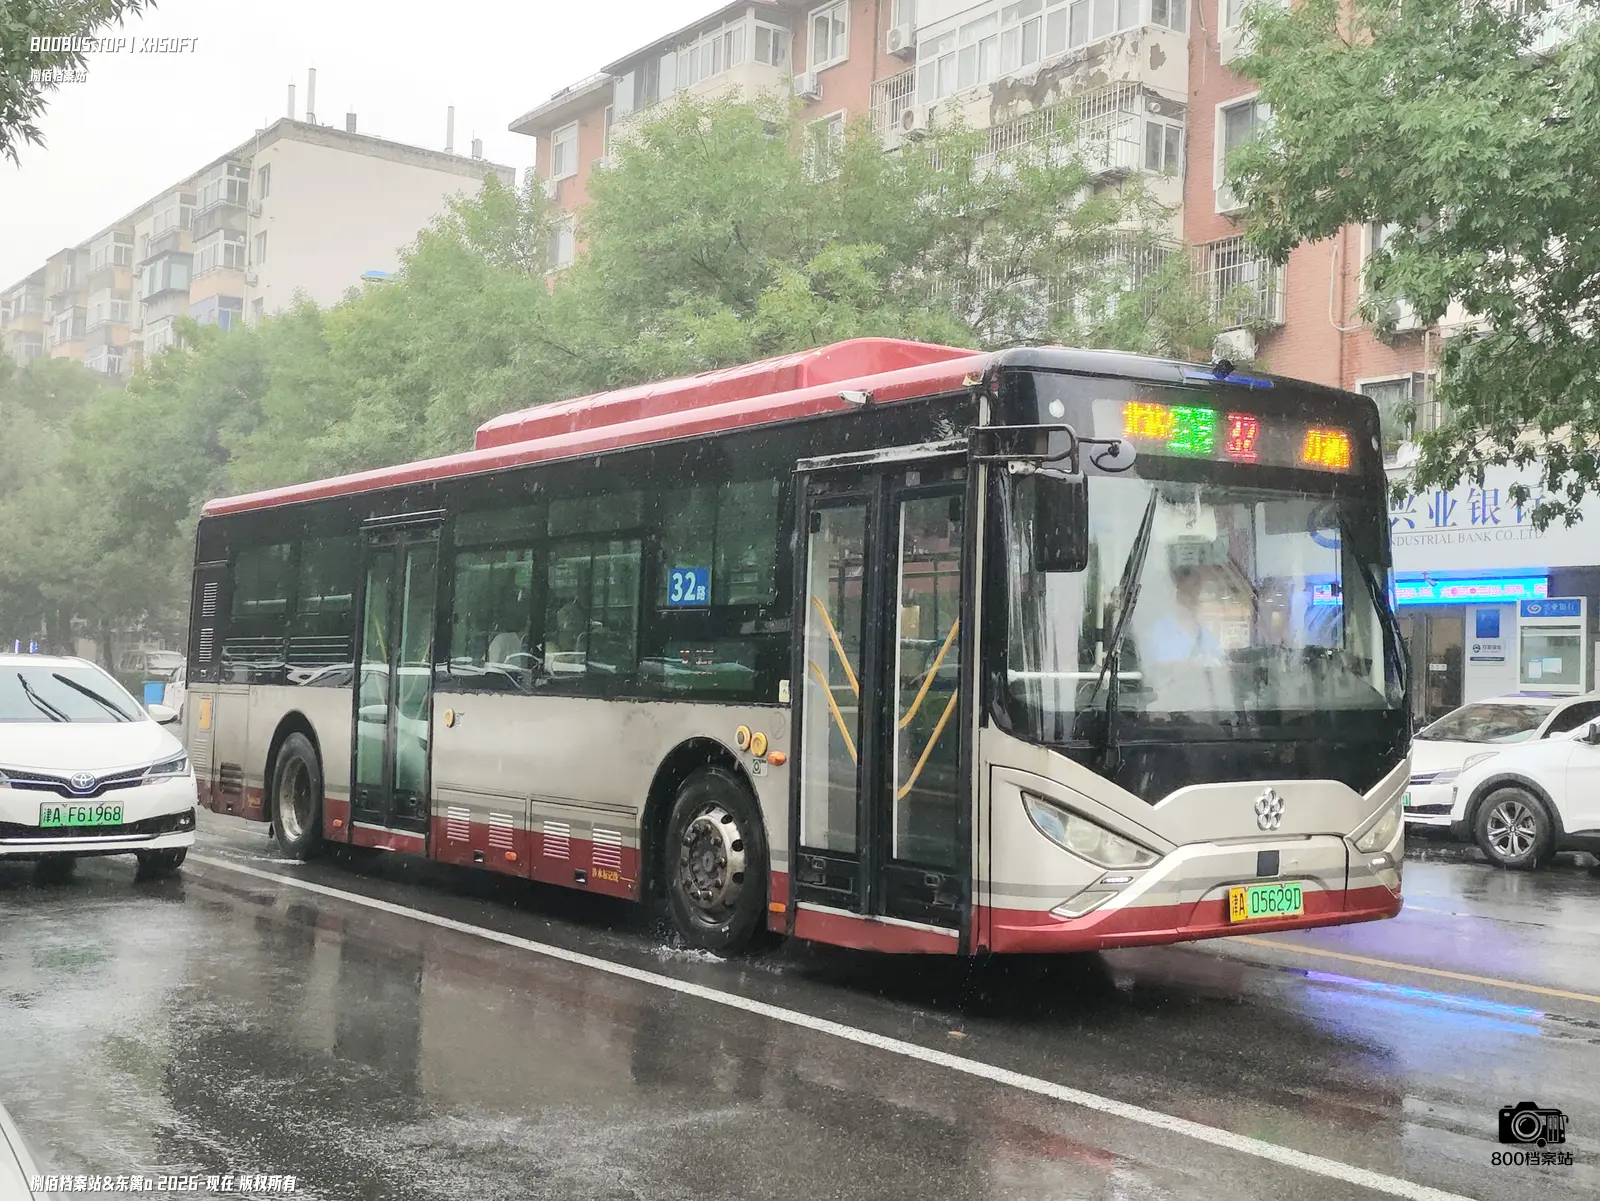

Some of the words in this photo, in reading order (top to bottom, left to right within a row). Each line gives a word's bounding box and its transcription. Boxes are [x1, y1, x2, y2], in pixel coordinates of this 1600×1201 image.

[1391, 533, 1455, 547] DUSTRIAL
[1458, 530, 1492, 544] BANK
[671, 571, 706, 602] 32路
[68, 806, 122, 823] F61968
[1251, 887, 1302, 914] 05629D
